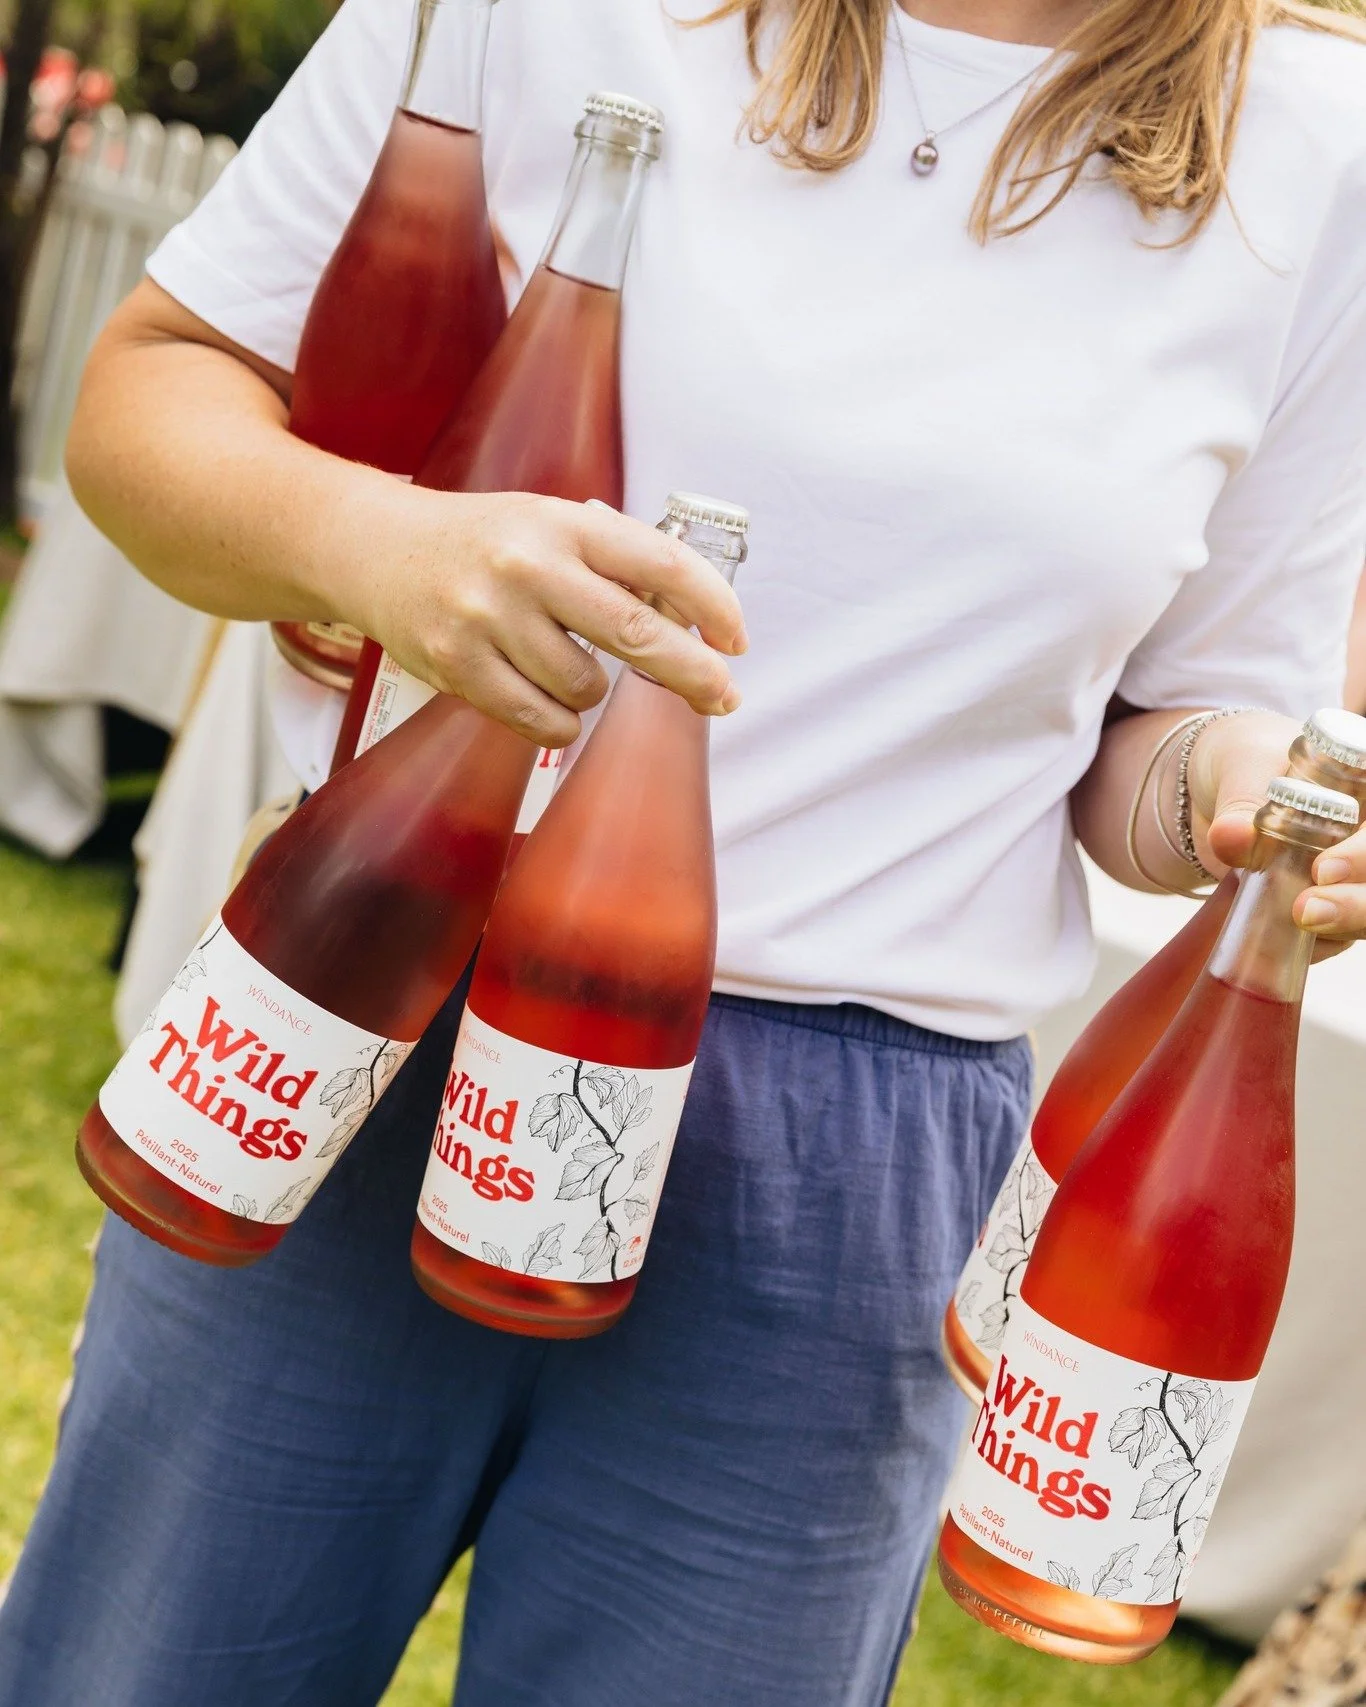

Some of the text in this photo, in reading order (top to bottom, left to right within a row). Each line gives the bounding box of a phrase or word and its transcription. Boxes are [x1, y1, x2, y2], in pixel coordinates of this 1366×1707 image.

[247, 984, 313, 1036] WINDANCE
[196, 996, 319, 1110] Wild
[149, 1021, 308, 1161] Things
[135, 1128, 224, 1195] Pétillant-Naturel
[169, 1138, 200, 1163] 2025
[433, 1108, 535, 1202] hings
[431, 1194, 449, 1213] 2025
[1023, 1329, 1081, 1374] WINDANCE
[994, 1353, 1099, 1459] Wild
[958, 1503, 1033, 1562] Pétillant-Naturel
[981, 1505, 1006, 1528] 2025
